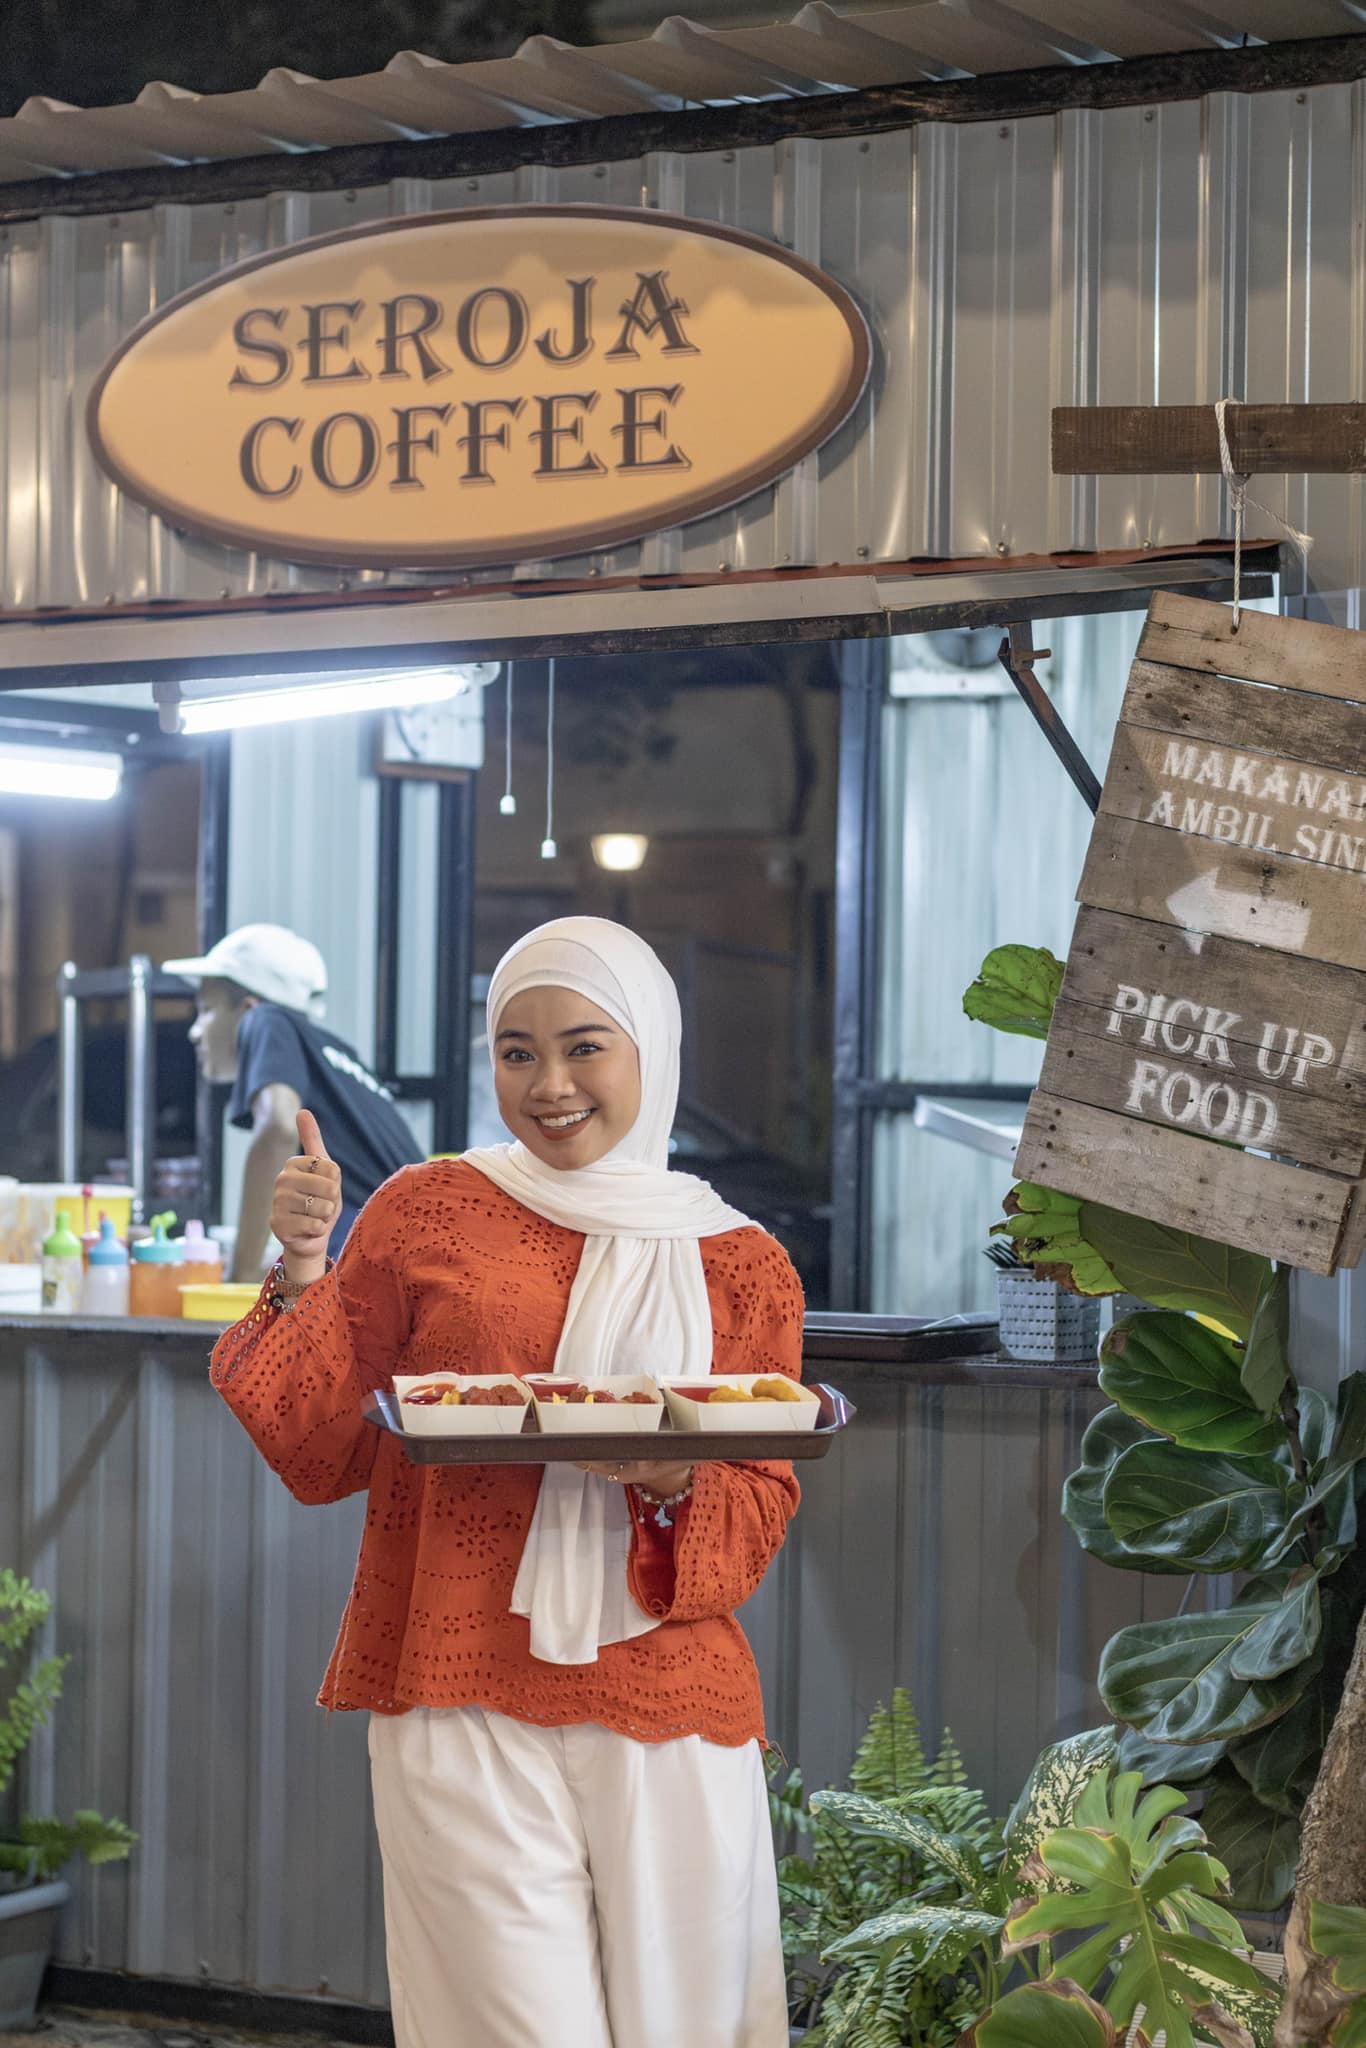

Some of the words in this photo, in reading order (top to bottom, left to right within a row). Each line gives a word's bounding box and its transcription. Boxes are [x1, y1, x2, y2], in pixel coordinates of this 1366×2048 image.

[228, 269, 700, 392] SEROJA
[237, 383, 692, 500] COFFEE
[1145, 791, 1278, 852] AMBIL
[1291, 823, 1366, 872] SIN
[1106, 983, 1242, 1068] PICK
[1257, 1022, 1336, 1087] UP
[1124, 1059, 1280, 1143] FOOD
